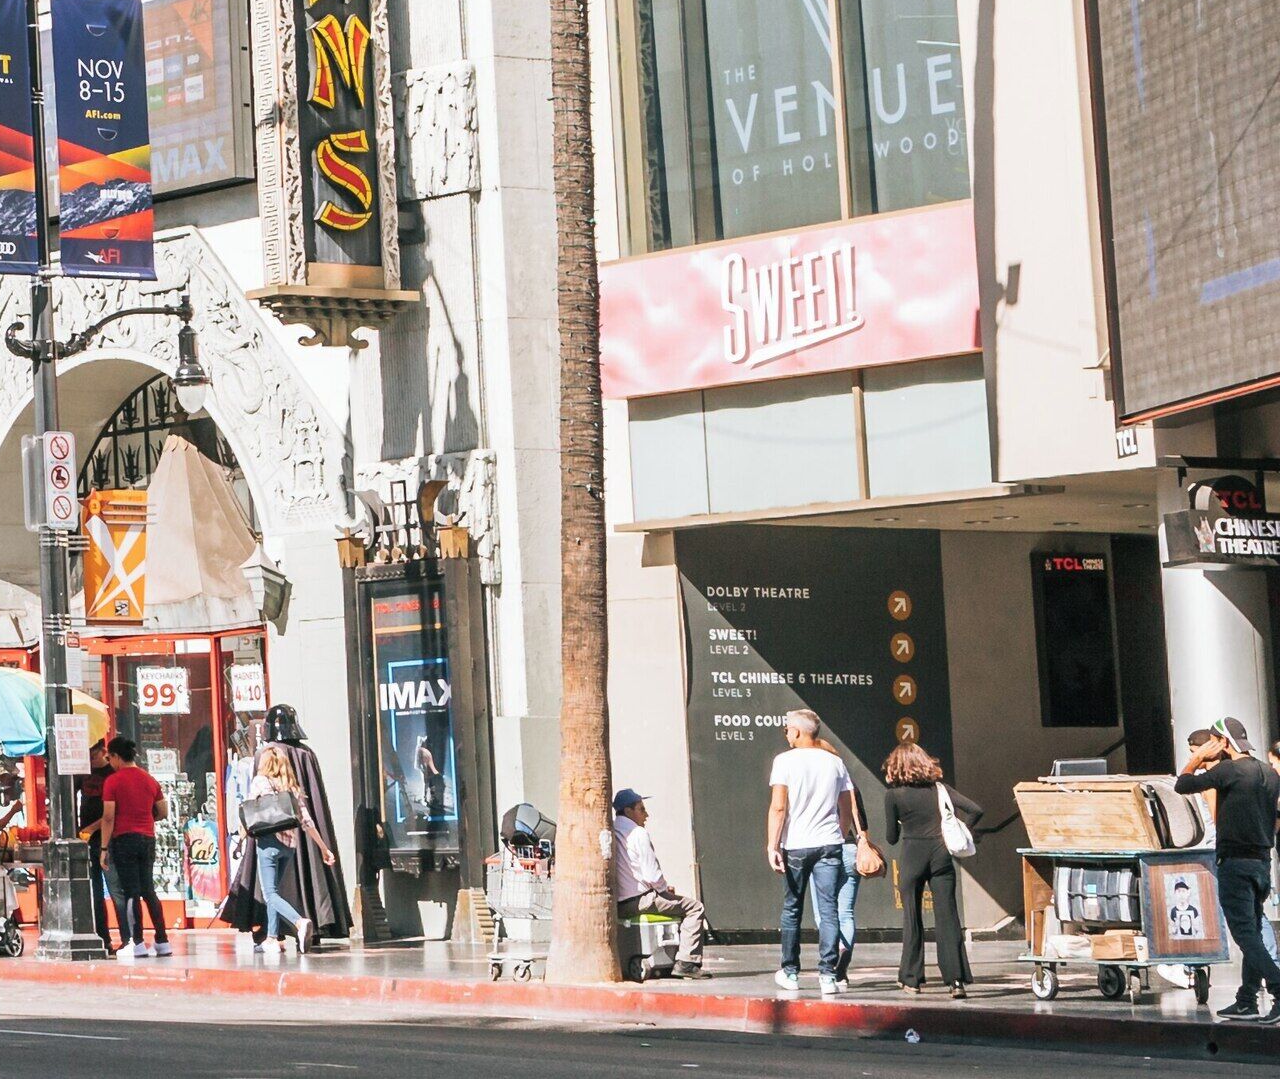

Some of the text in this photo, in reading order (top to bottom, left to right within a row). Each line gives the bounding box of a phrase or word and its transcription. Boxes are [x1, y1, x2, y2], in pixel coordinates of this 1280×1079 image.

[77, 58, 124, 80] NOV
[724, 64, 757, 85] THE
[85, 109, 122, 121] AFI.com
[150, 136, 229, 186] MAX
[732, 165, 760, 185] OF
[783, 128, 960, 176] HOLWOOD
[721, 242, 860, 364] SWEET!
[1116, 429, 1139, 457] TCL
[1217, 490, 1262, 510] TCL
[1053, 557, 1083, 570] TCL
[707, 586, 811, 599] DOLBY THEATRE
[707, 603, 738, 612] LEVEL
[709, 628, 758, 640] SWEET!
[710, 645, 749, 655] LEVEL 2
[711, 672, 874, 686] TCL CHINESE 6 THEATRES
[379, 679, 453, 711] IMAX
[713, 688, 752, 697] LEVEL 3
[714, 715, 789, 727] FOOD COUR
[715, 731, 754, 741] LEVEL 3
